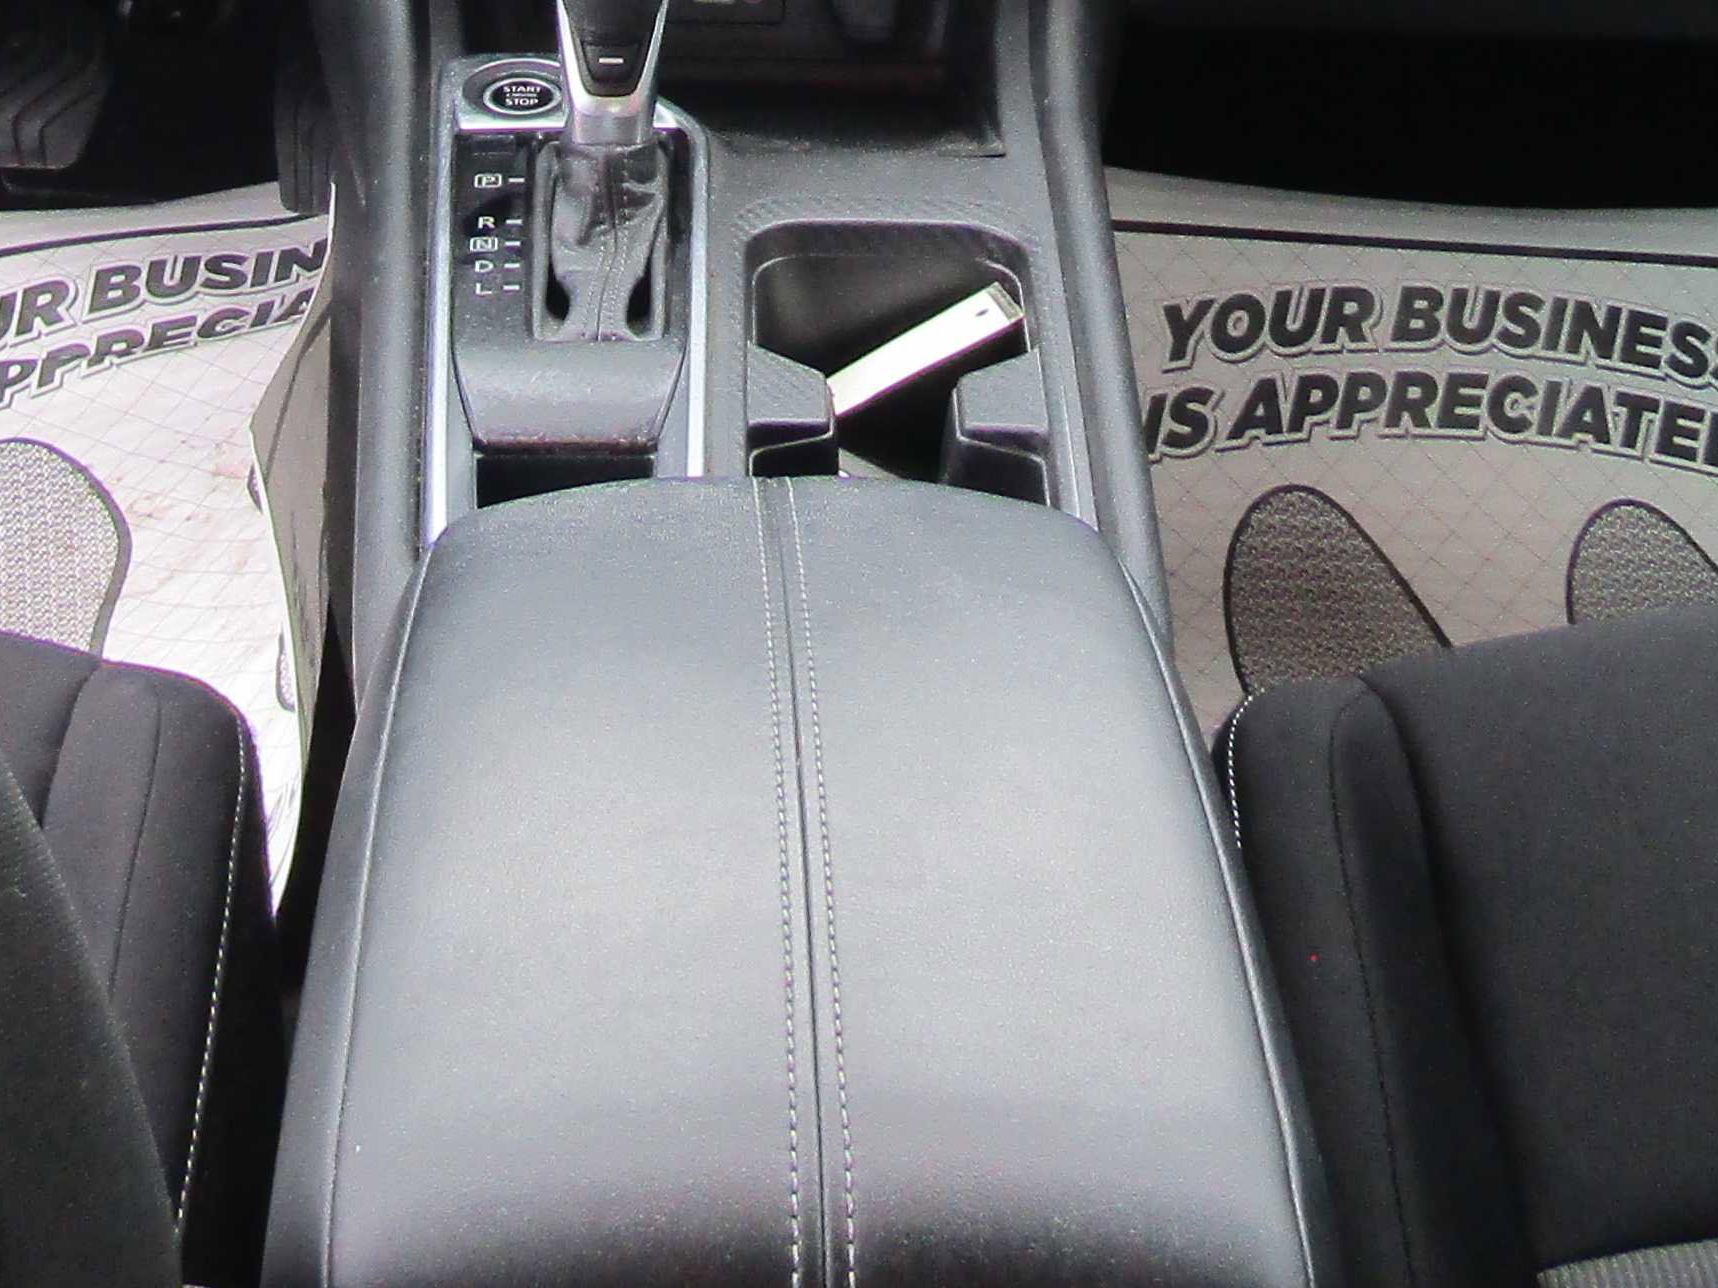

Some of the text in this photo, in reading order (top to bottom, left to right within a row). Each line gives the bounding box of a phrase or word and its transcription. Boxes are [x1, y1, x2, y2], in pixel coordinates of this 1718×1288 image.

[503, 85, 542, 94] START
[505, 97, 540, 106] STOP
[478, 215, 496, 230] R
[475, 259, 494, 274] D
[87, 236, 329, 318] BUSIN
[475, 282, 493, 296] L
[1161, 284, 1378, 368] YOUR
[1146, 387, 1218, 458] IS
